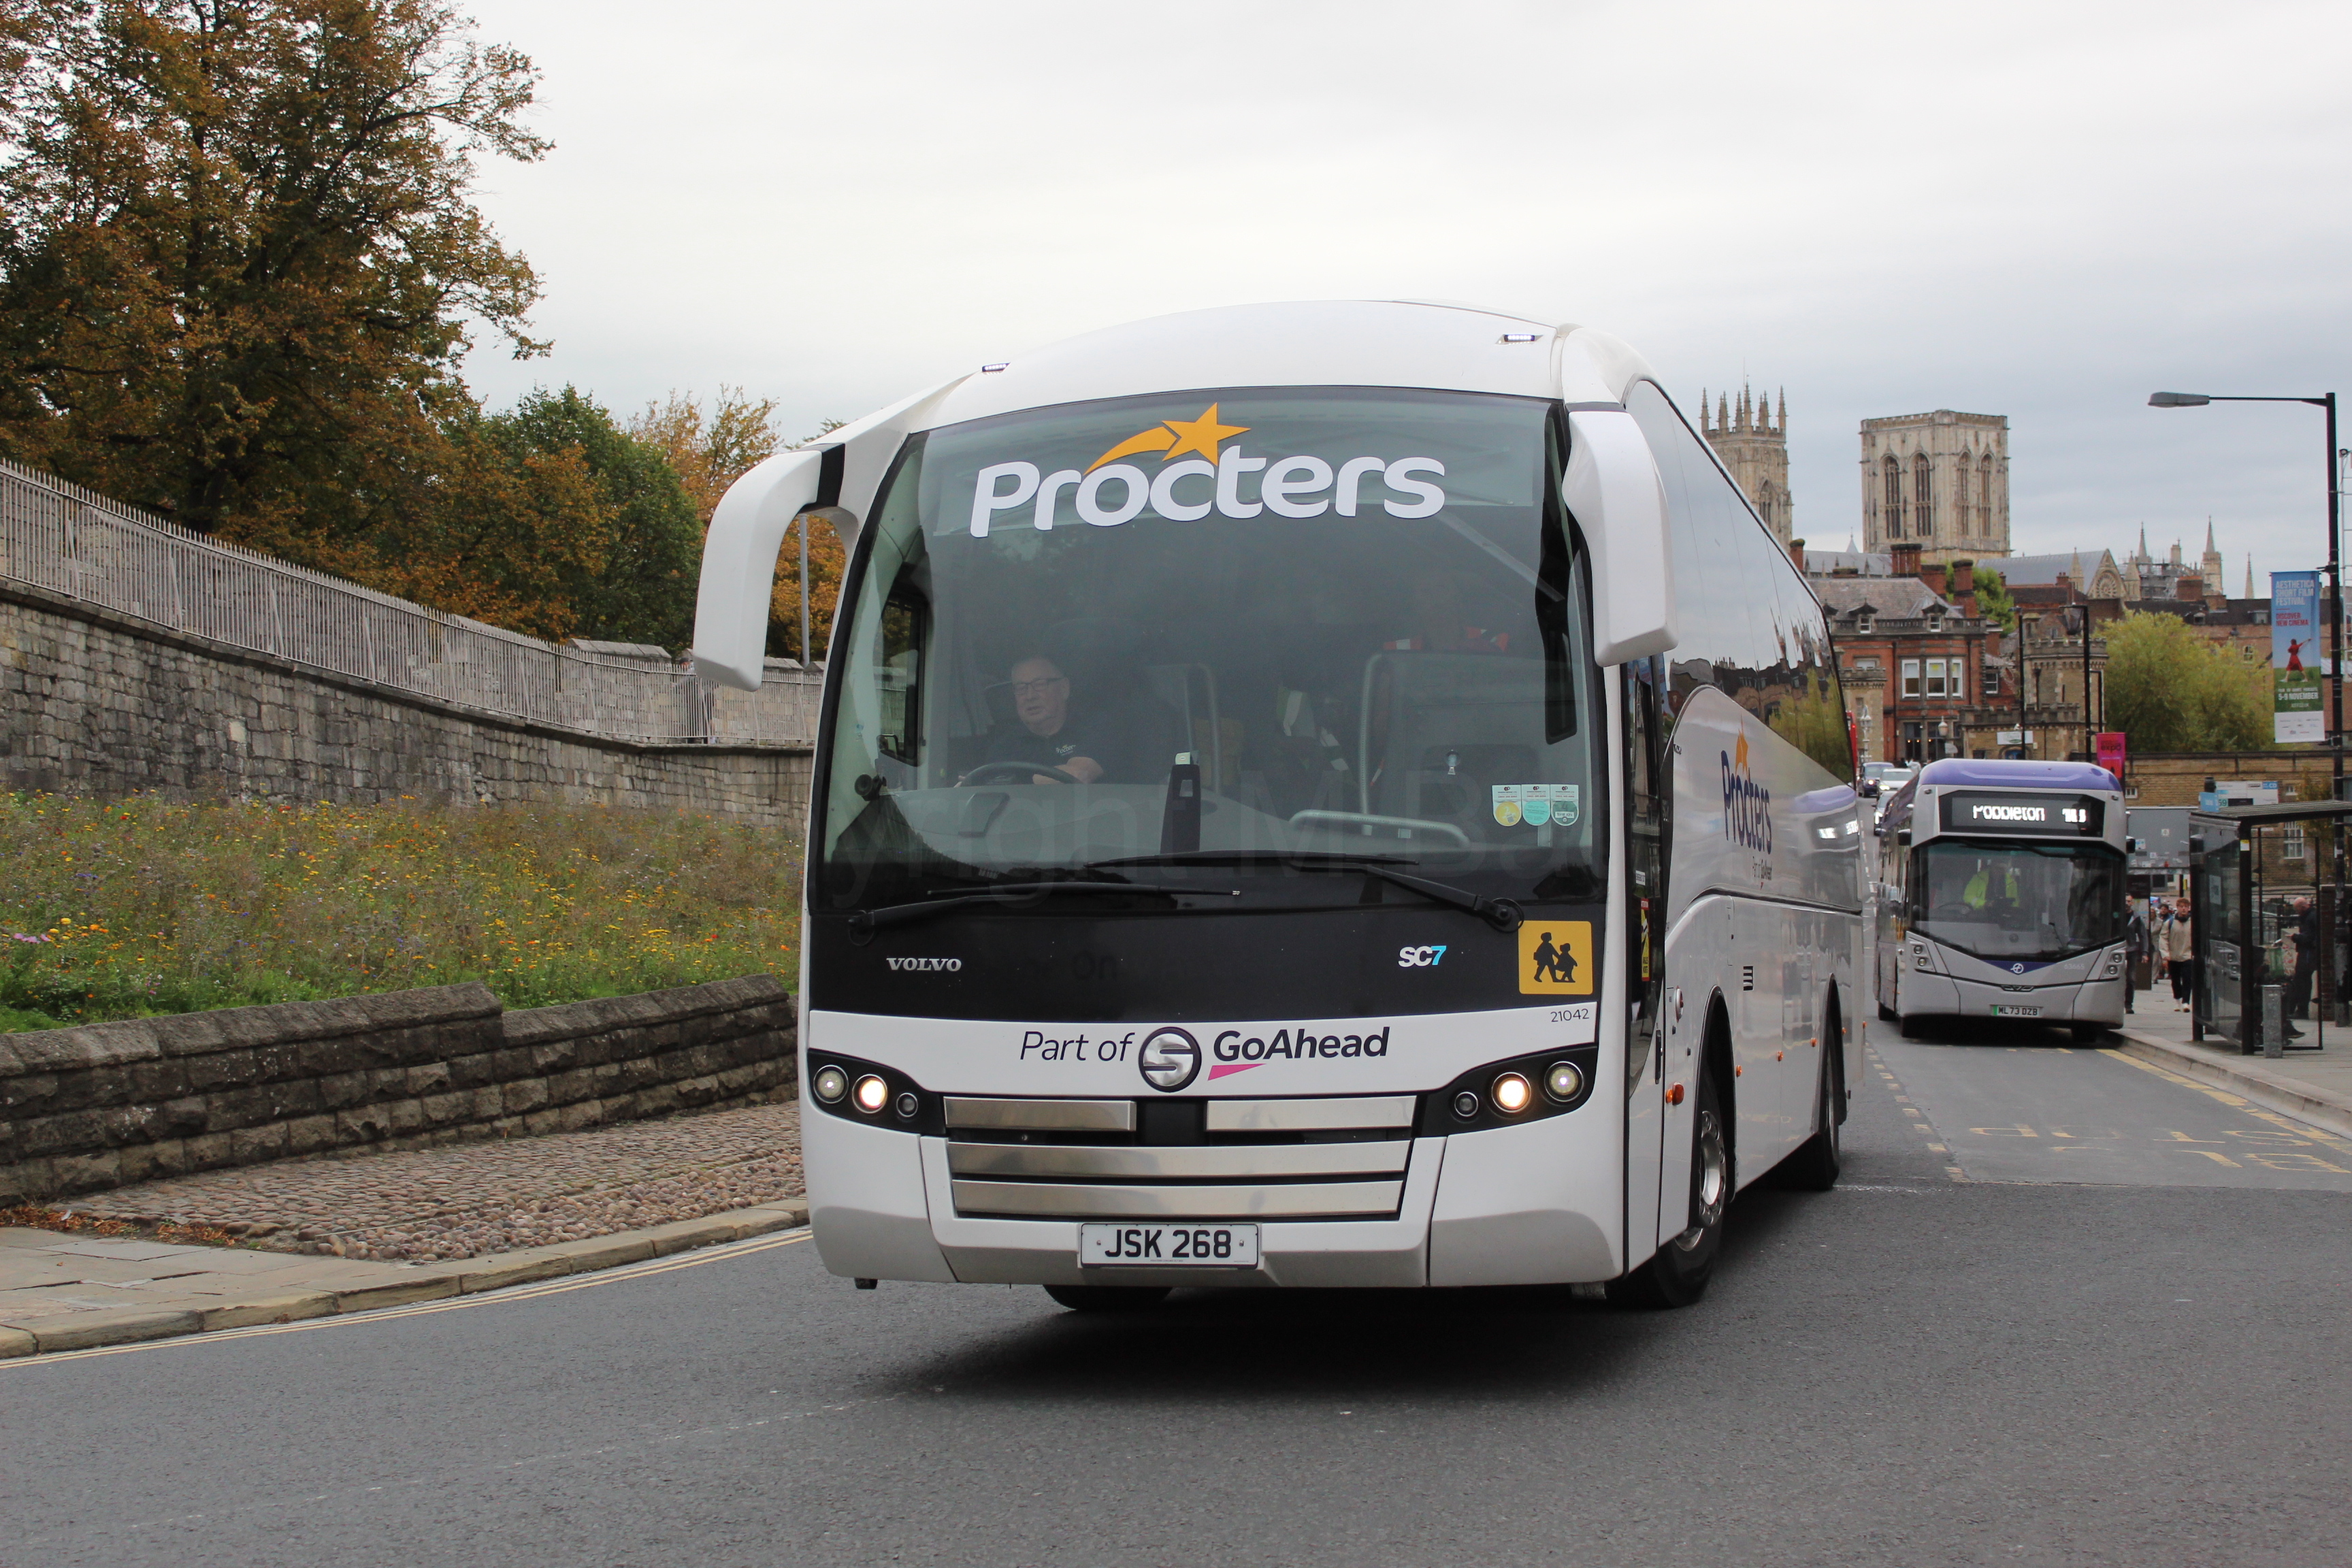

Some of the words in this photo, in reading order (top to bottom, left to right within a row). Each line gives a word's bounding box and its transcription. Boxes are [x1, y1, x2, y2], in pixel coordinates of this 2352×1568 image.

[970, 445, 1445, 538] Procters
[2276, 597, 2306, 606] FESTIVAL
[1720, 750, 1771, 855] Procters
[886, 958, 962, 972] VOLVO
[1398, 945, 1447, 967] SC7
[1550, 1009, 1590, 1023] 21042
[1019, 1031, 1089, 1061] Part
[1097, 1032, 1135, 1062] of
[1213, 1026, 1390, 1061] GoAhead
[1105, 1229, 1162, 1258] JSK
[1172, 1229, 1231, 1258] 268
